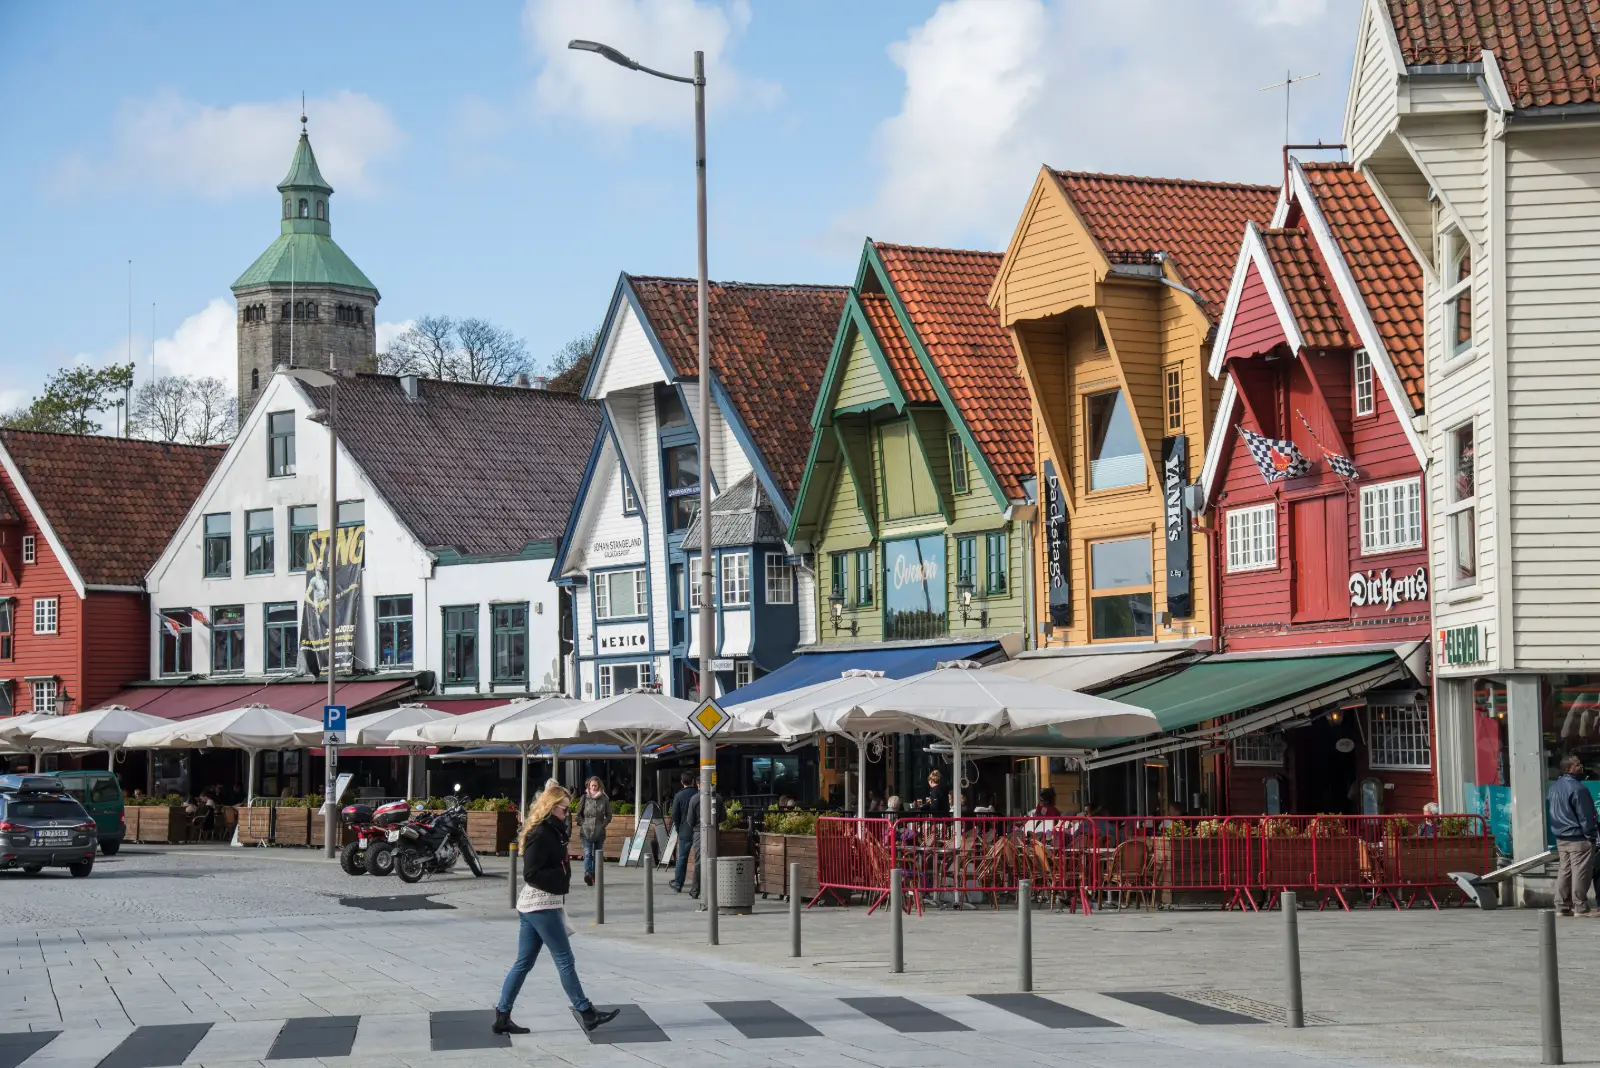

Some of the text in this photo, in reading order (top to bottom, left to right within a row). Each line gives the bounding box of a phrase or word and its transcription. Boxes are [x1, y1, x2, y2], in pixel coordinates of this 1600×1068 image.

[306, 525, 365, 571] STNG
[1049, 475, 1063, 588] backstage
[1348, 566, 1428, 612] Dickens
[328, 708, 341, 728] P
